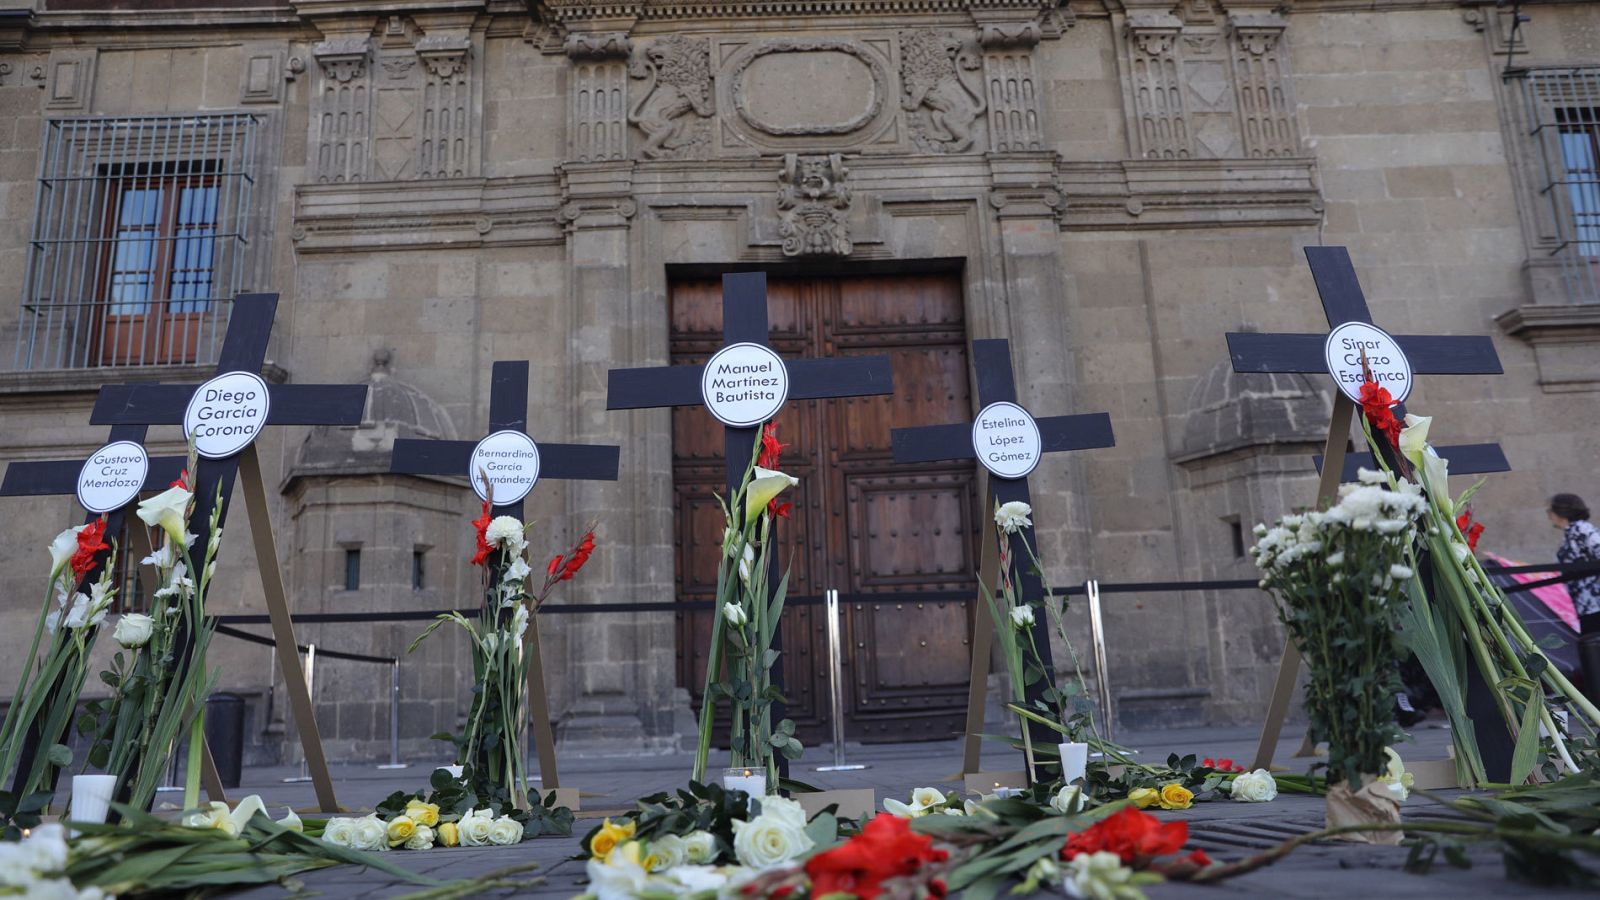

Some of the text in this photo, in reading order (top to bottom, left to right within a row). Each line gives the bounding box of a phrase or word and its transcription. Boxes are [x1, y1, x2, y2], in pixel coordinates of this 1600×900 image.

[1342, 338, 1380, 350] Sinar
[717, 361, 772, 375] Manuel
[712, 376, 779, 389] Martínez
[1339, 369, 1405, 385] Esqinca
[205, 389, 256, 404] Diego
[716, 390, 775, 403] Bautista
[197, 405, 257, 420] García
[982, 417, 1026, 430] Estelina
[194, 423, 255, 438] Corona
[989, 435, 1024, 447] López
[478, 448, 534, 459] Bernardino
[988, 452, 1032, 463] Gómez
[93, 455, 142, 465] Gustavo
[486, 461, 522, 471] García
[101, 466, 128, 476] Cruz
[83, 477, 139, 488] Mendoza
[476, 474, 531, 484] Hrnández
